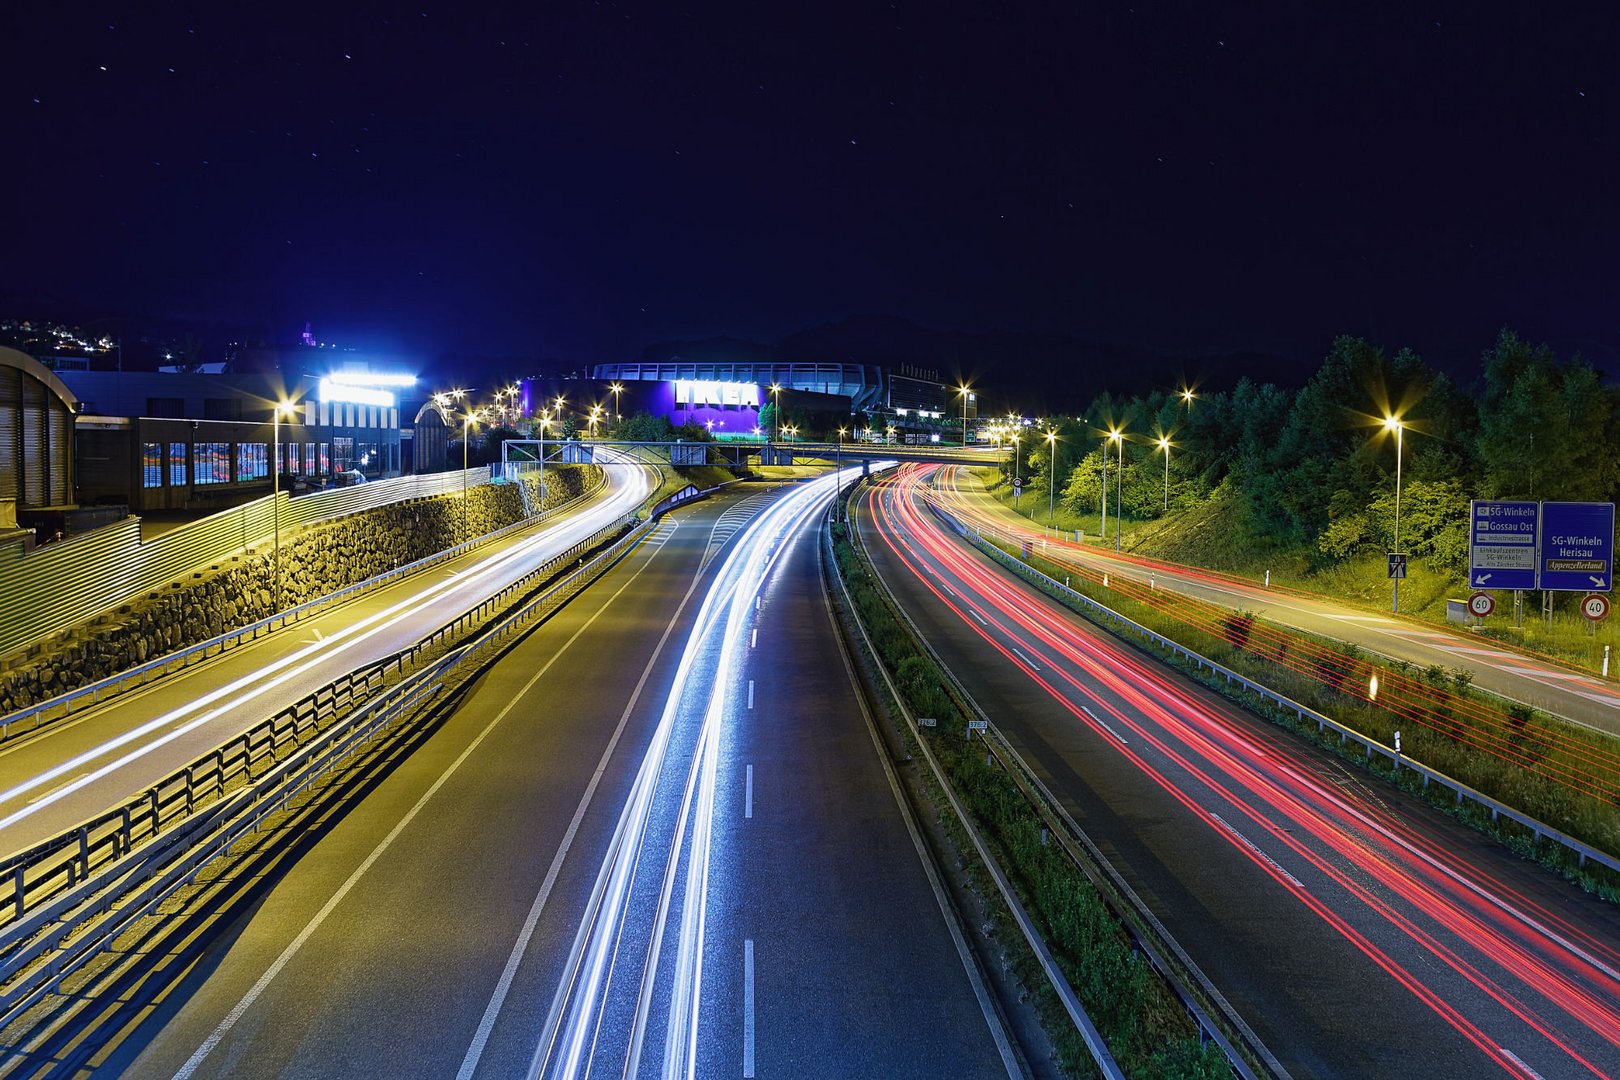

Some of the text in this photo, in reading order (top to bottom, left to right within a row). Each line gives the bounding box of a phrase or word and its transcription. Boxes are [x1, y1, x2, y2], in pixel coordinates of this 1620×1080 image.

[1490, 507, 1535, 516] SG-Winkeln
[1490, 522, 1533, 531] Gossau Ost
[1551, 536, 1602, 546] SG-Winkeln
[1560, 548, 1593, 557] Herisau
[1549, 561, 1604, 570] Appenzellerland
[1476, 600, 1487, 610] 60
[1589, 603, 1601, 613] 40
